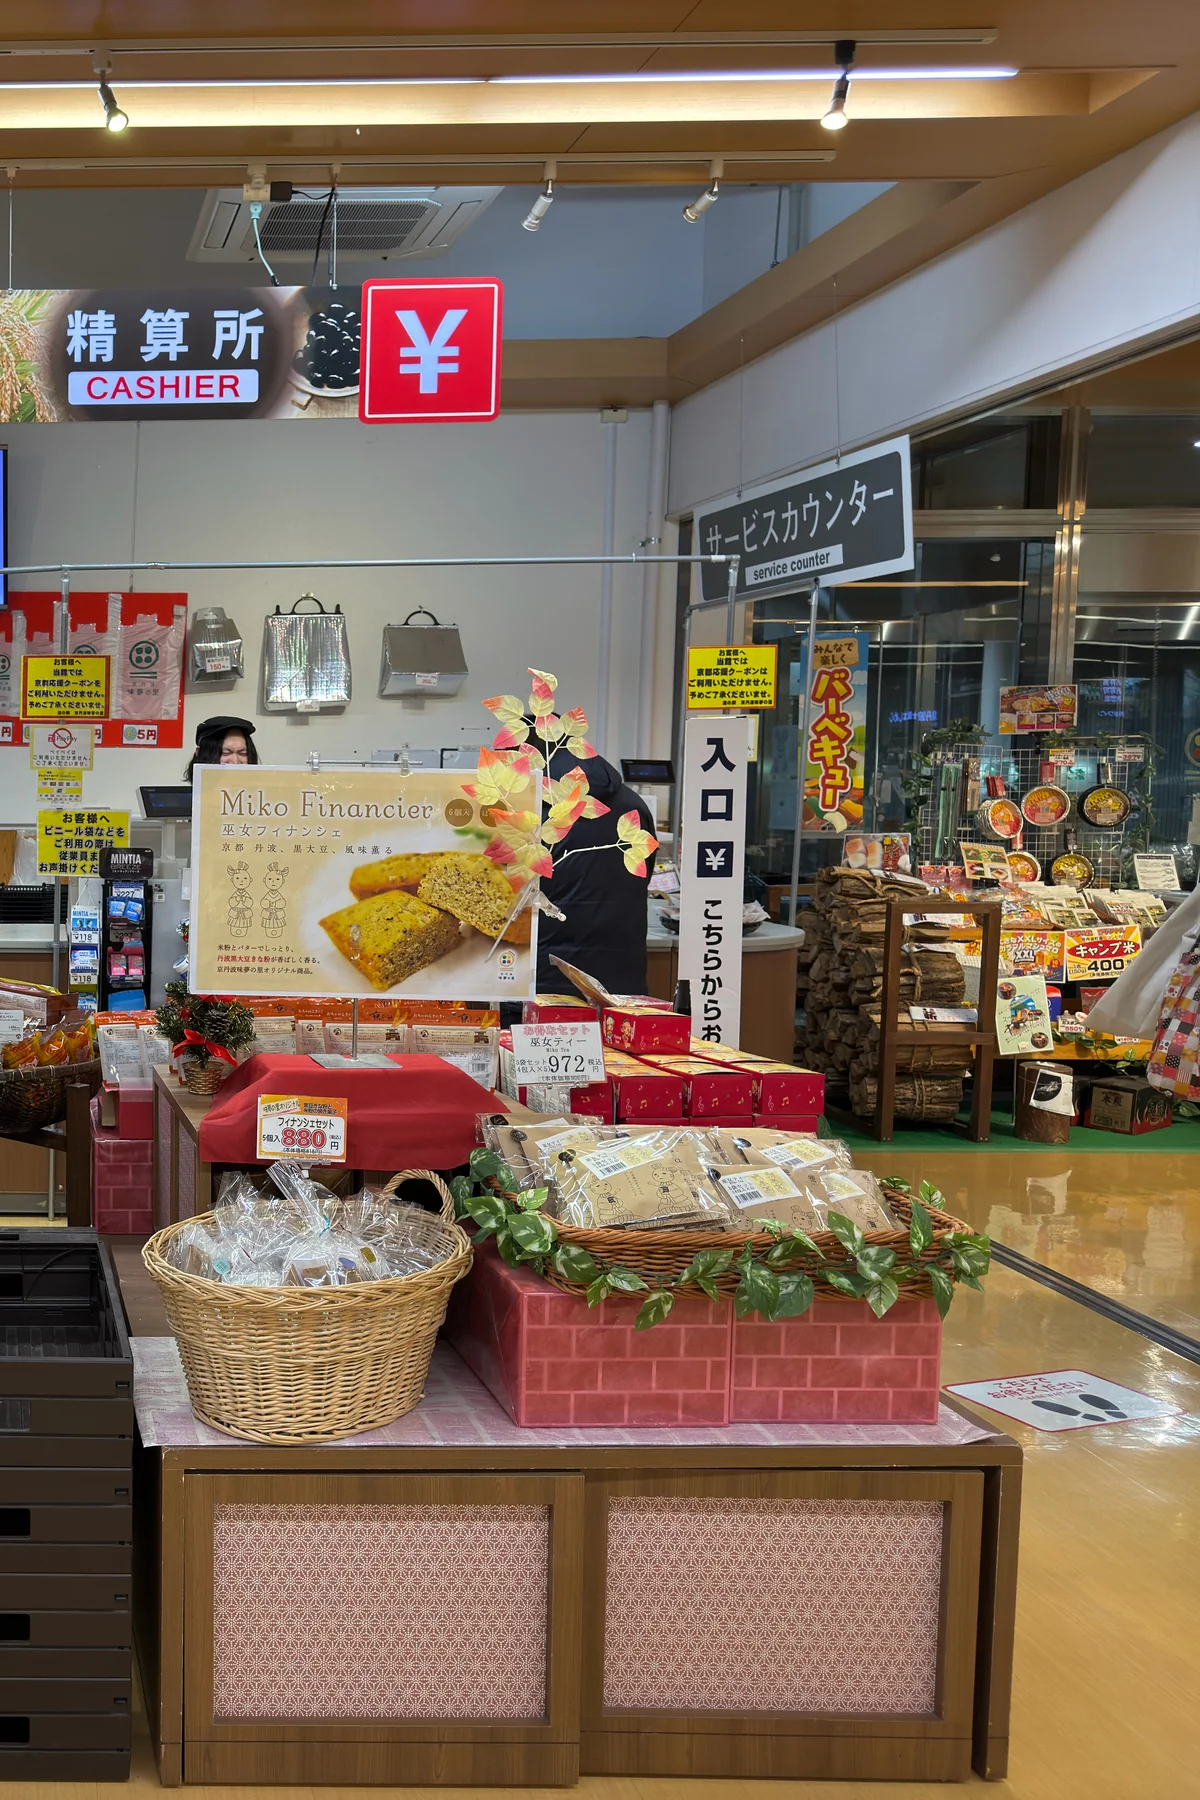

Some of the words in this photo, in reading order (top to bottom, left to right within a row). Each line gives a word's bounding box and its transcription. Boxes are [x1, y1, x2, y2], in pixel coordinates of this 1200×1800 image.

[66, 308, 265, 363] 精算所
[86, 375, 241, 400] CASHIER
[706, 479, 894, 555] サービスカウンター
[753, 560, 788, 581] service
[790, 550, 831, 572] counter
[813, 641, 854, 653] みんなで
[54, 658, 81, 666] お客様へ
[820, 655, 846, 666] 楽しく
[697, 668, 768, 676] 京都応援クーポンは
[688, 679, 772, 687] ご利用いただけません。
[27, 690, 104, 698] ご利用いただけません。
[137, 728, 156, 741] 5円
[812, 671, 850, 808] バーベキュー
[701, 738, 736, 821] 入口
[220, 789, 288, 817] Miko
[301, 790, 434, 819] Financier
[62, 813, 110, 824] お客様へ
[448, 808, 470, 817] 6個入
[44, 826, 125, 837] ビニール袋などを
[222, 823, 342, 838] 巫女フィナンシェ
[54, 839, 114, 849] ご利用の際は
[222, 843, 244, 852] 京都
[255, 842, 393, 855] 丹波、黒大豆、風味薫る
[110, 854, 142, 865] MINTIA
[217, 954, 320, 964] 丹波黒大豆きな粉が香ばしく香る。
[217, 965, 315, 975] 京丹波味夢の里オリジナル商品。
[1087, 959, 1125, 972] 400
[523, 1024, 590, 1036] お得なセット
[530, 1037, 586, 1047] 巫女ティー
[548, 1055, 585, 1073] 972
[588, 1058, 602, 1066] 税込
[278, 1117, 334, 1129] フィナンシェセット
[262, 1134, 280, 1142] 5個入
[281, 1127, 327, 1149] 880
[992, 1377, 1048, 1389] こちらで
[986, 1380, 1090, 1399] お待ちください
